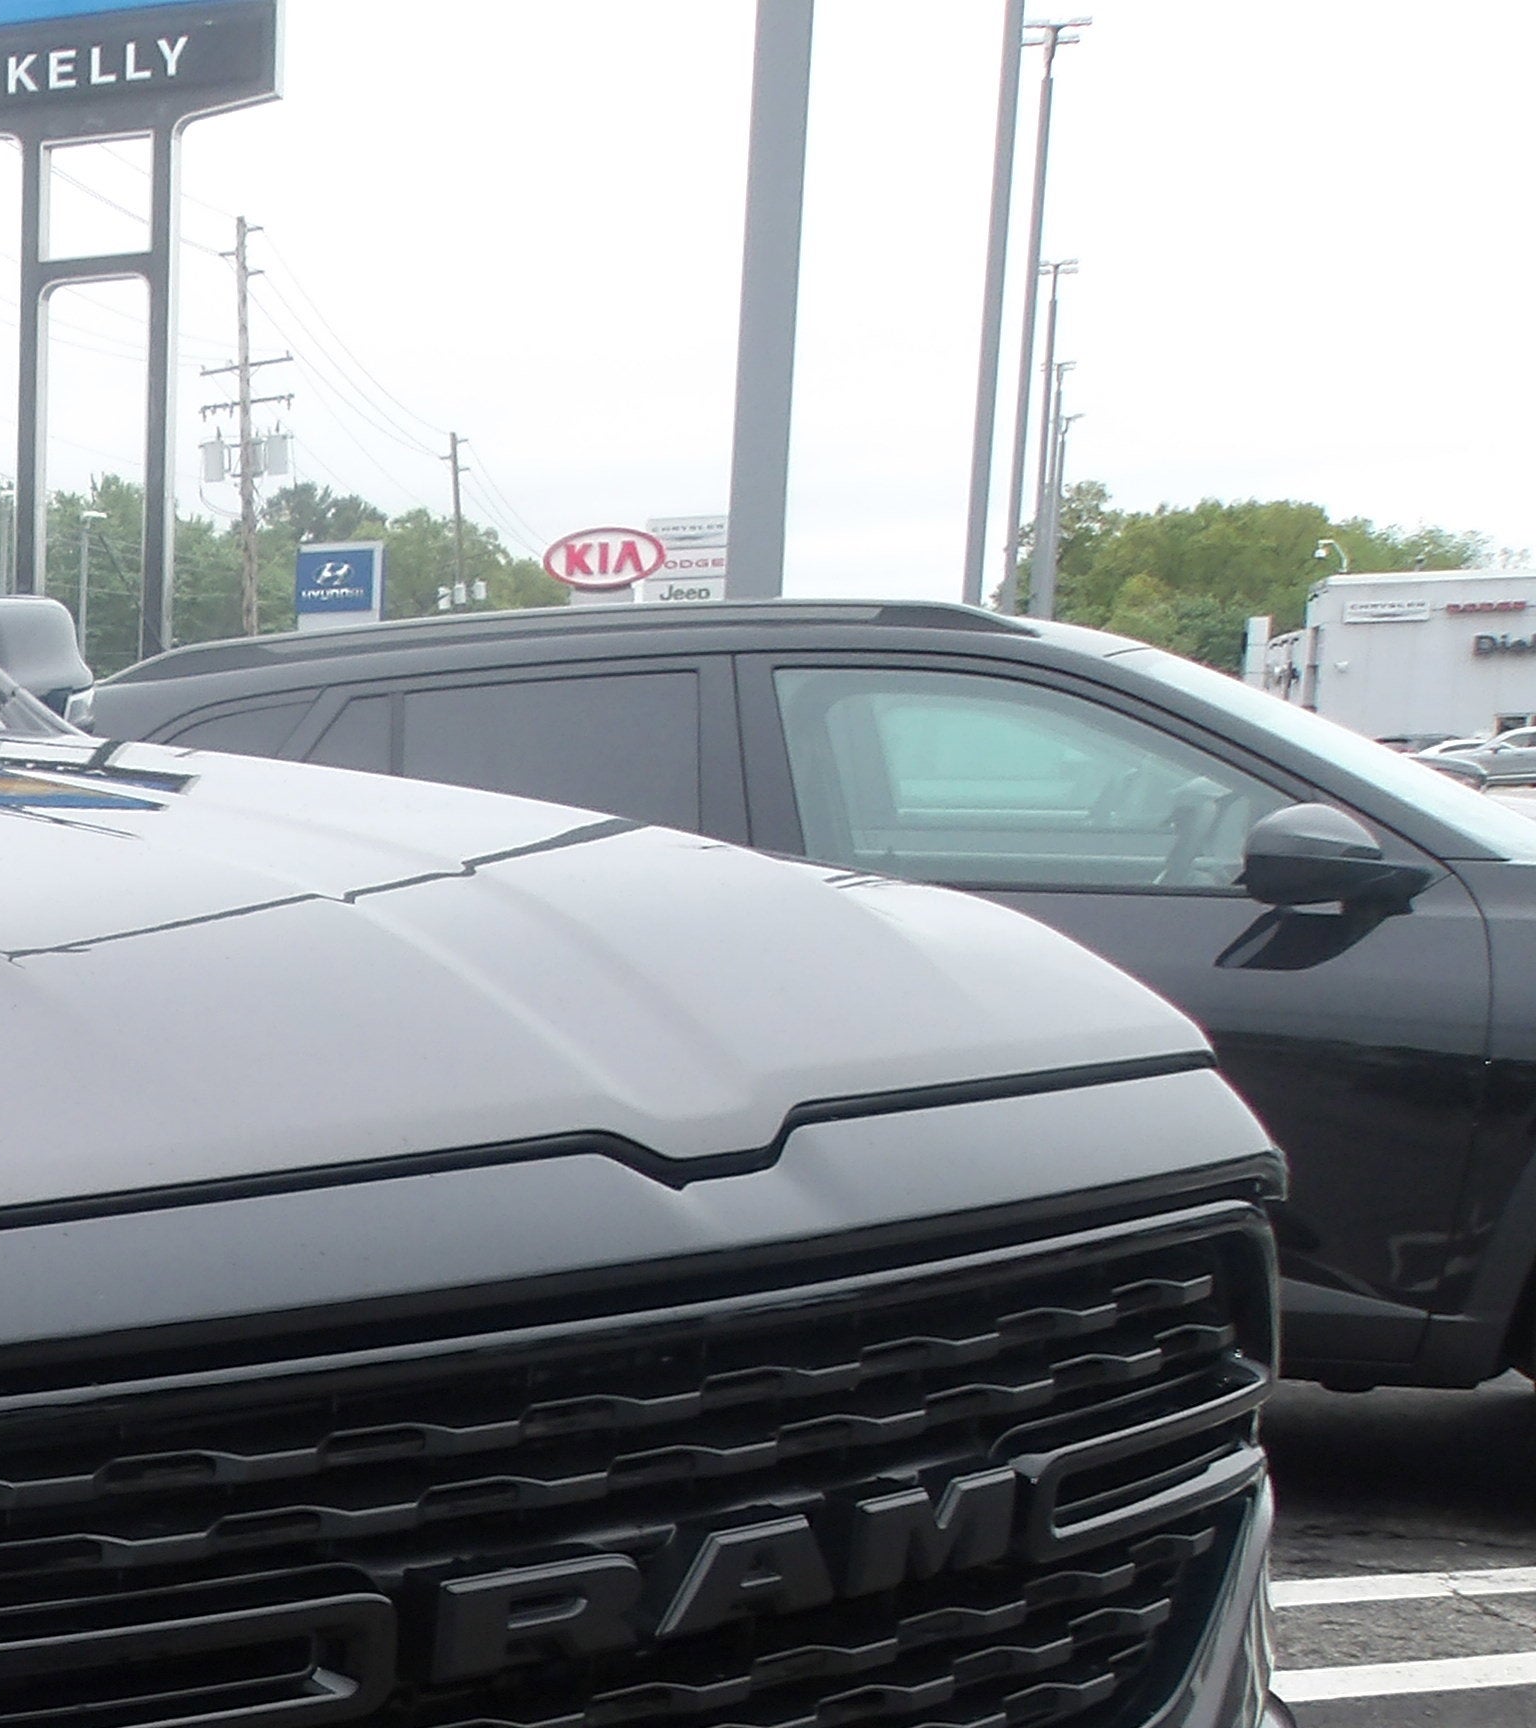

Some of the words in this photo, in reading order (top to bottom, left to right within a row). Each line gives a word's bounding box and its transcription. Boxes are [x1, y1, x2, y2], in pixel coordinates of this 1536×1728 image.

[6, 36, 189, 95] KELLY
[564, 540, 643, 577] KIA
[663, 558, 725, 570] ODGE
[430, 1464, 1018, 1681] RAM
